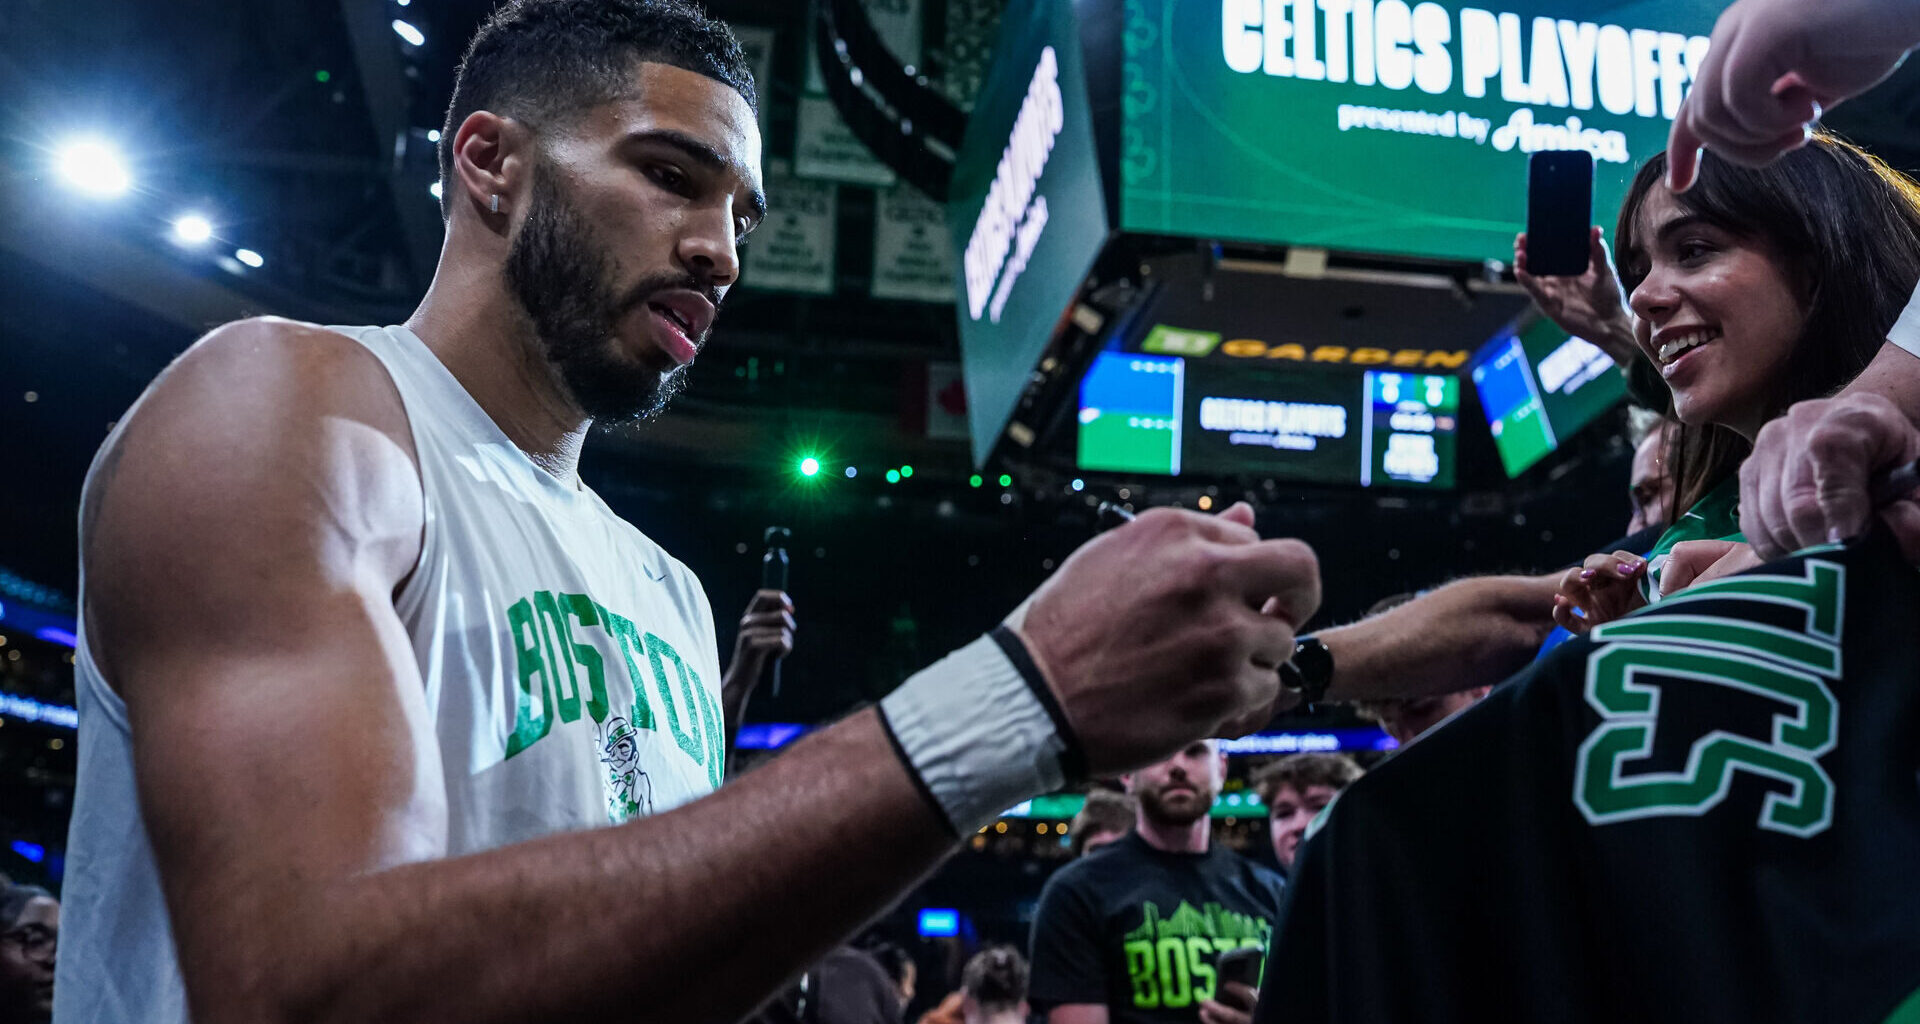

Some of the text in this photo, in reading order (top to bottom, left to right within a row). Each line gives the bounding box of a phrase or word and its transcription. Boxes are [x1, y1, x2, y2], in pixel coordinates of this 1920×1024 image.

[1221, 0, 1453, 95] CELTICS
[1337, 103, 1630, 163] presented by Amica
[1222, 338, 1468, 368] GARDEN
[504, 590, 725, 791] BOSTON
[1124, 935, 1266, 1010] BOS
